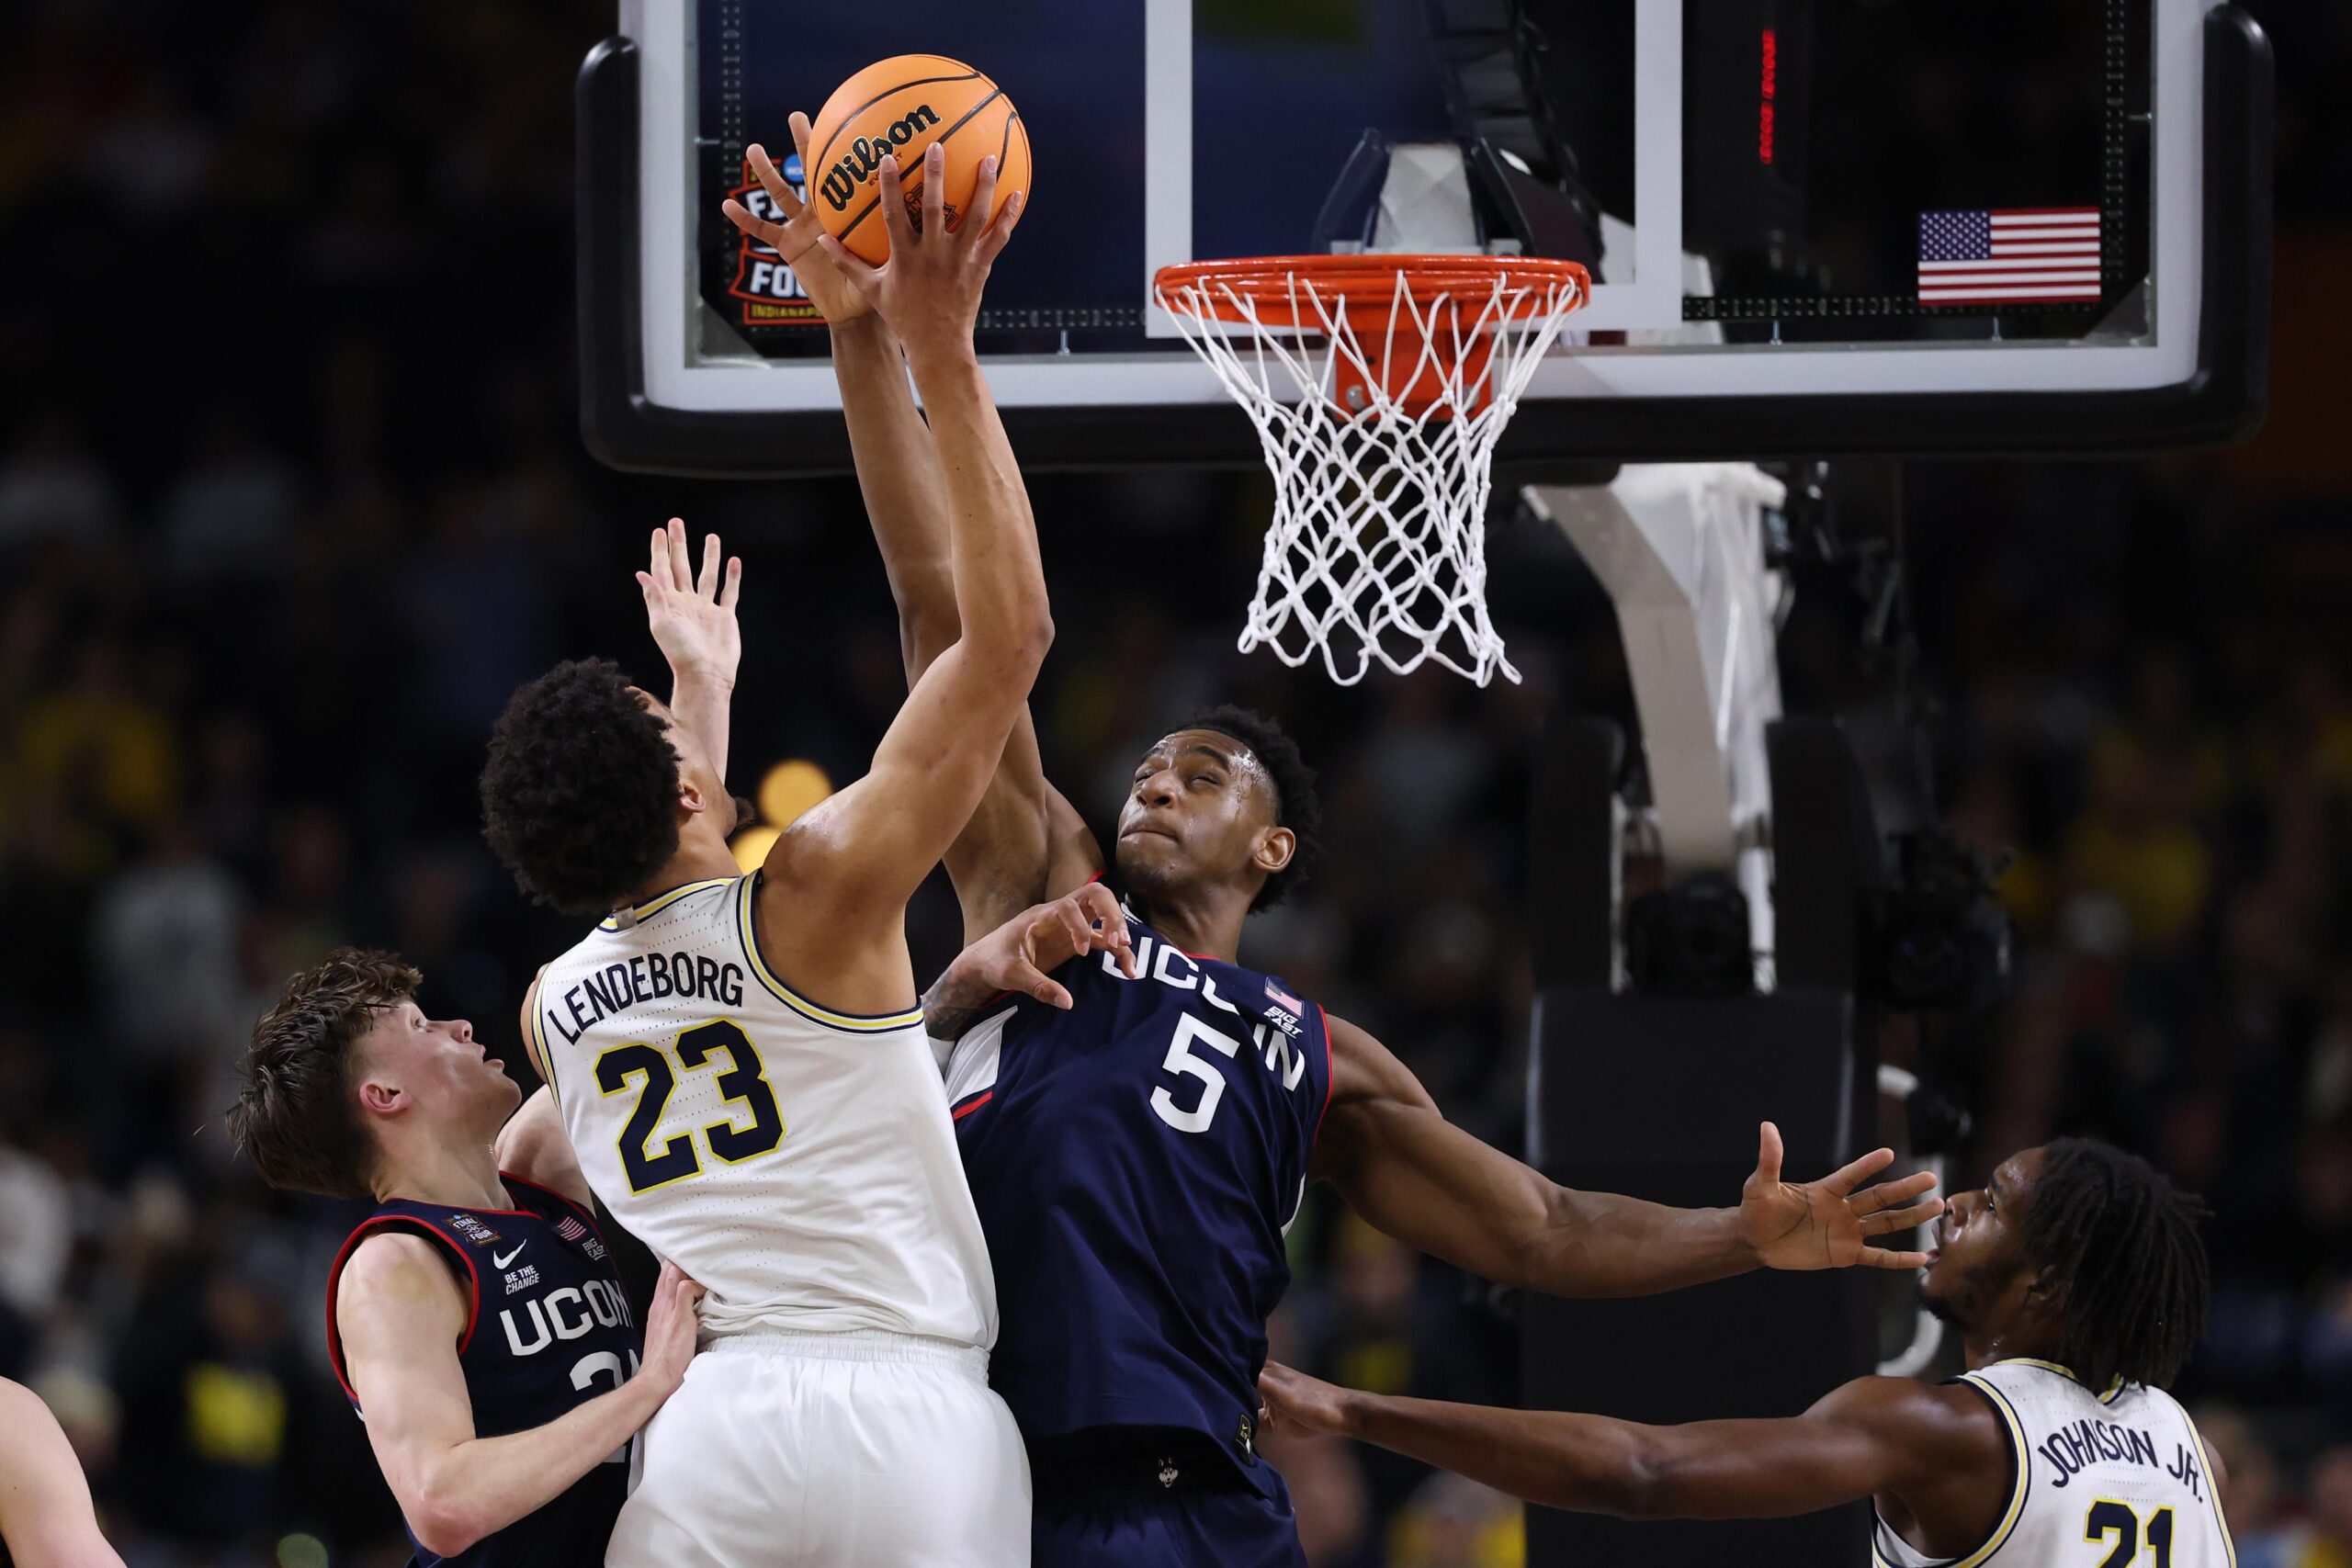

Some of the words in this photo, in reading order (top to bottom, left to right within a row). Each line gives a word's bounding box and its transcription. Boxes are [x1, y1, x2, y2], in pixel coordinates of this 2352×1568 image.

[820, 104, 943, 212] Wilson
[750, 261, 808, 298] FO
[548, 952, 744, 1045] LENDEBORG
[1267, 1005, 1299, 1024] BIG
[1150, 1011, 1240, 1134] 5
[593, 1016, 786, 1197] 23
[452, 1217, 478, 1228] FINAL
[469, 1229, 493, 1240] FOUR
[582, 1237, 598, 1251] BIG
[504, 1271, 518, 1284] BE
[517, 1265, 537, 1279] THE
[505, 1273, 540, 1295] CHANGE
[2038, 1418, 2159, 1488] JOHNSON
[2166, 1442, 2203, 1504] JR.
[2083, 1497, 2175, 1568] 21
